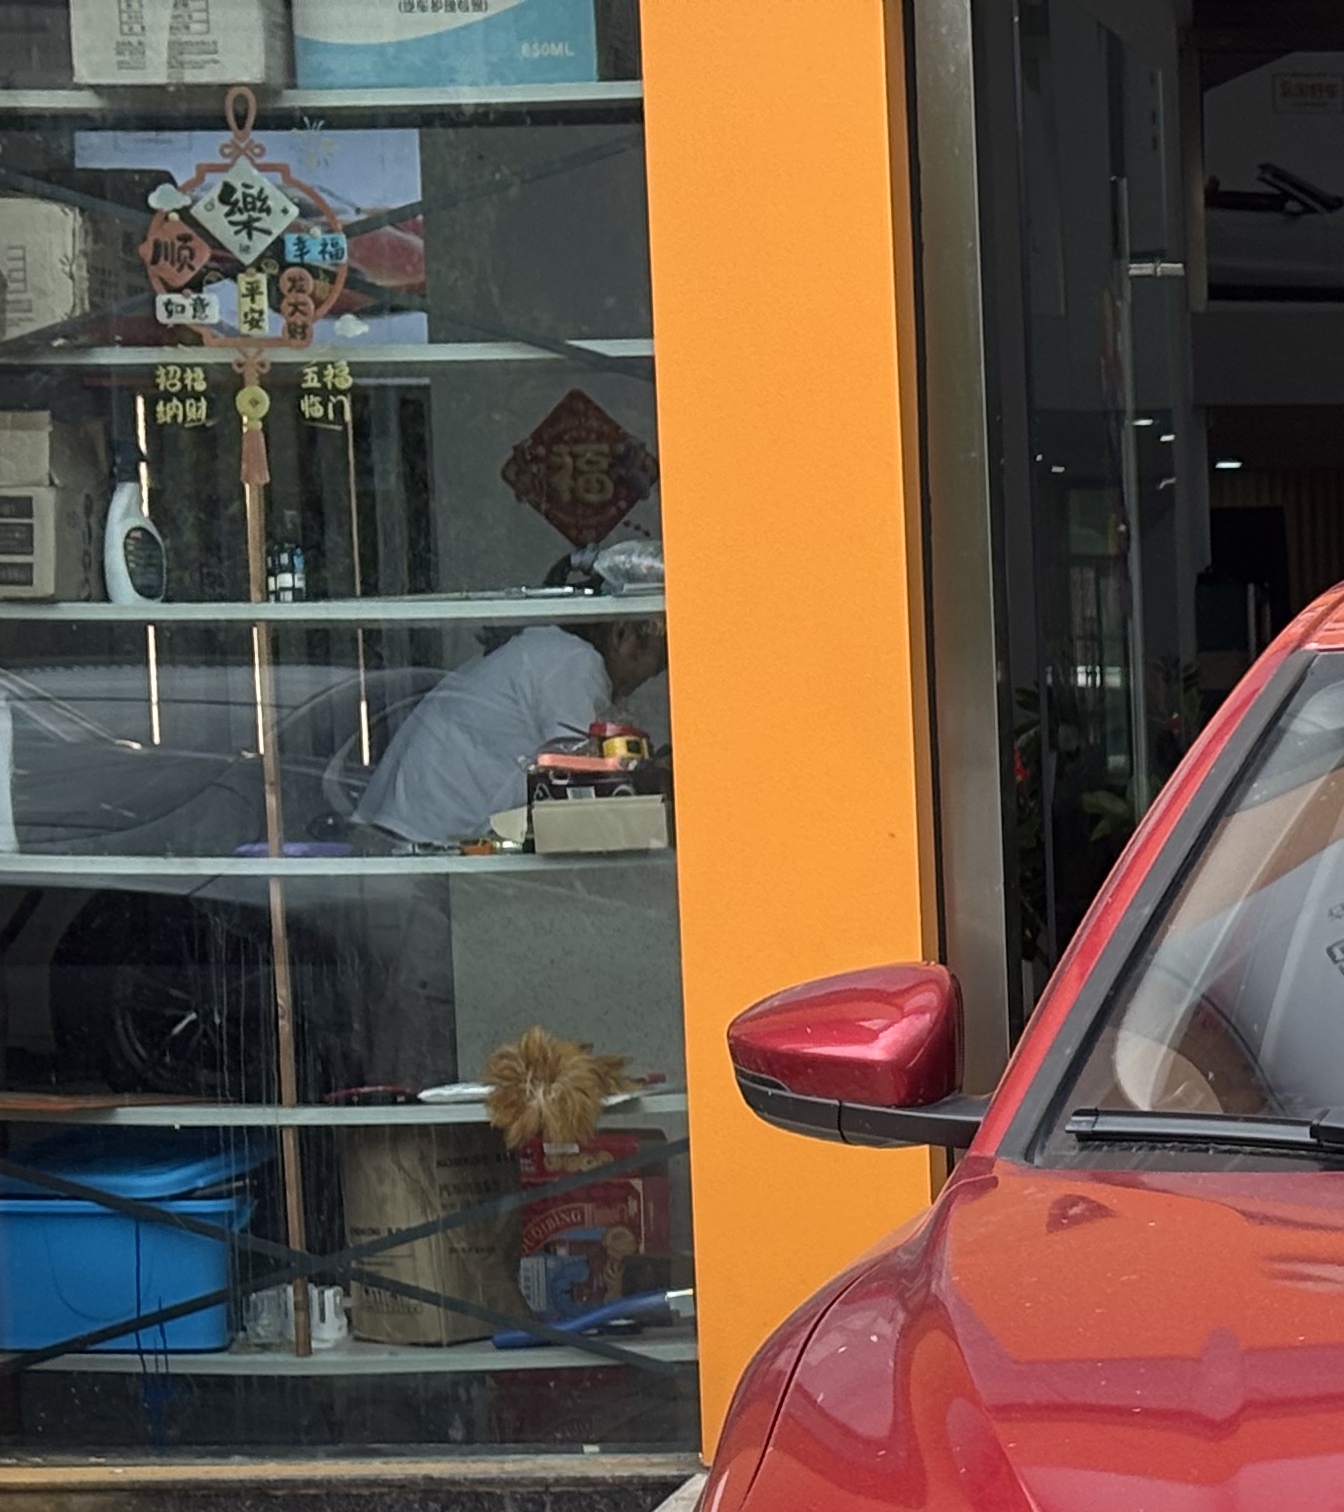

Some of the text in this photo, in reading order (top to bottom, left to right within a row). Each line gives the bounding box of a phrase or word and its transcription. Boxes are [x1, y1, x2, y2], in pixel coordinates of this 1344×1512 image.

[218, 180, 272, 240] 樂
[151, 232, 197, 272] 顺
[291, 236, 346, 261] 幸福
[163, 295, 212, 321] 如意
[241, 281, 266, 331] 平安
[300, 360, 354, 391] 五福
[156, 395, 208, 424] 纳财
[300, 394, 351, 423] 临门
[551, 442, 615, 504] 福
